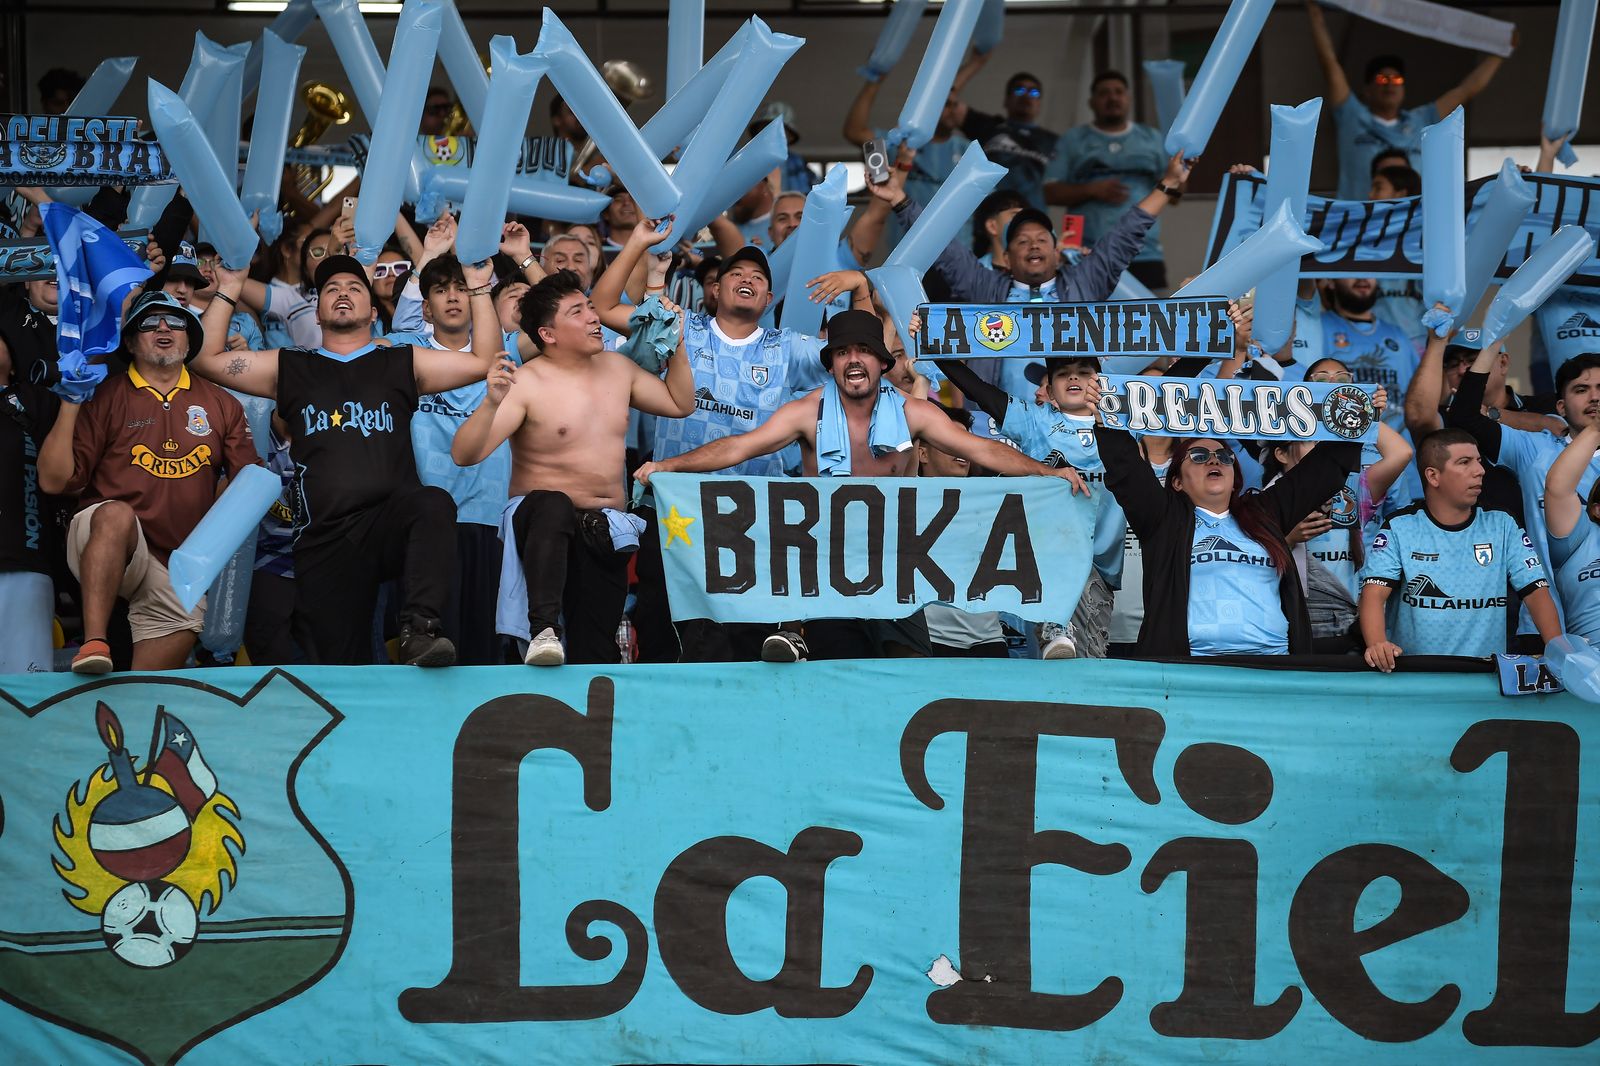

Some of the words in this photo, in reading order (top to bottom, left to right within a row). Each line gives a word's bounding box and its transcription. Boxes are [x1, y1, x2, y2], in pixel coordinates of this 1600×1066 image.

[919, 308, 971, 354] LA
[1022, 301, 1232, 352] TENIENTE
[302, 403, 329, 437] La
[1125, 380, 1317, 437] REALES
[139, 451, 207, 475] CRISTAL
[24, 463, 42, 550] PASIÓN
[700, 480, 1042, 604] BROKA
[1515, 663, 1559, 692] LA
[398, 675, 874, 1024] La
[900, 698, 1600, 1048] Fiel
